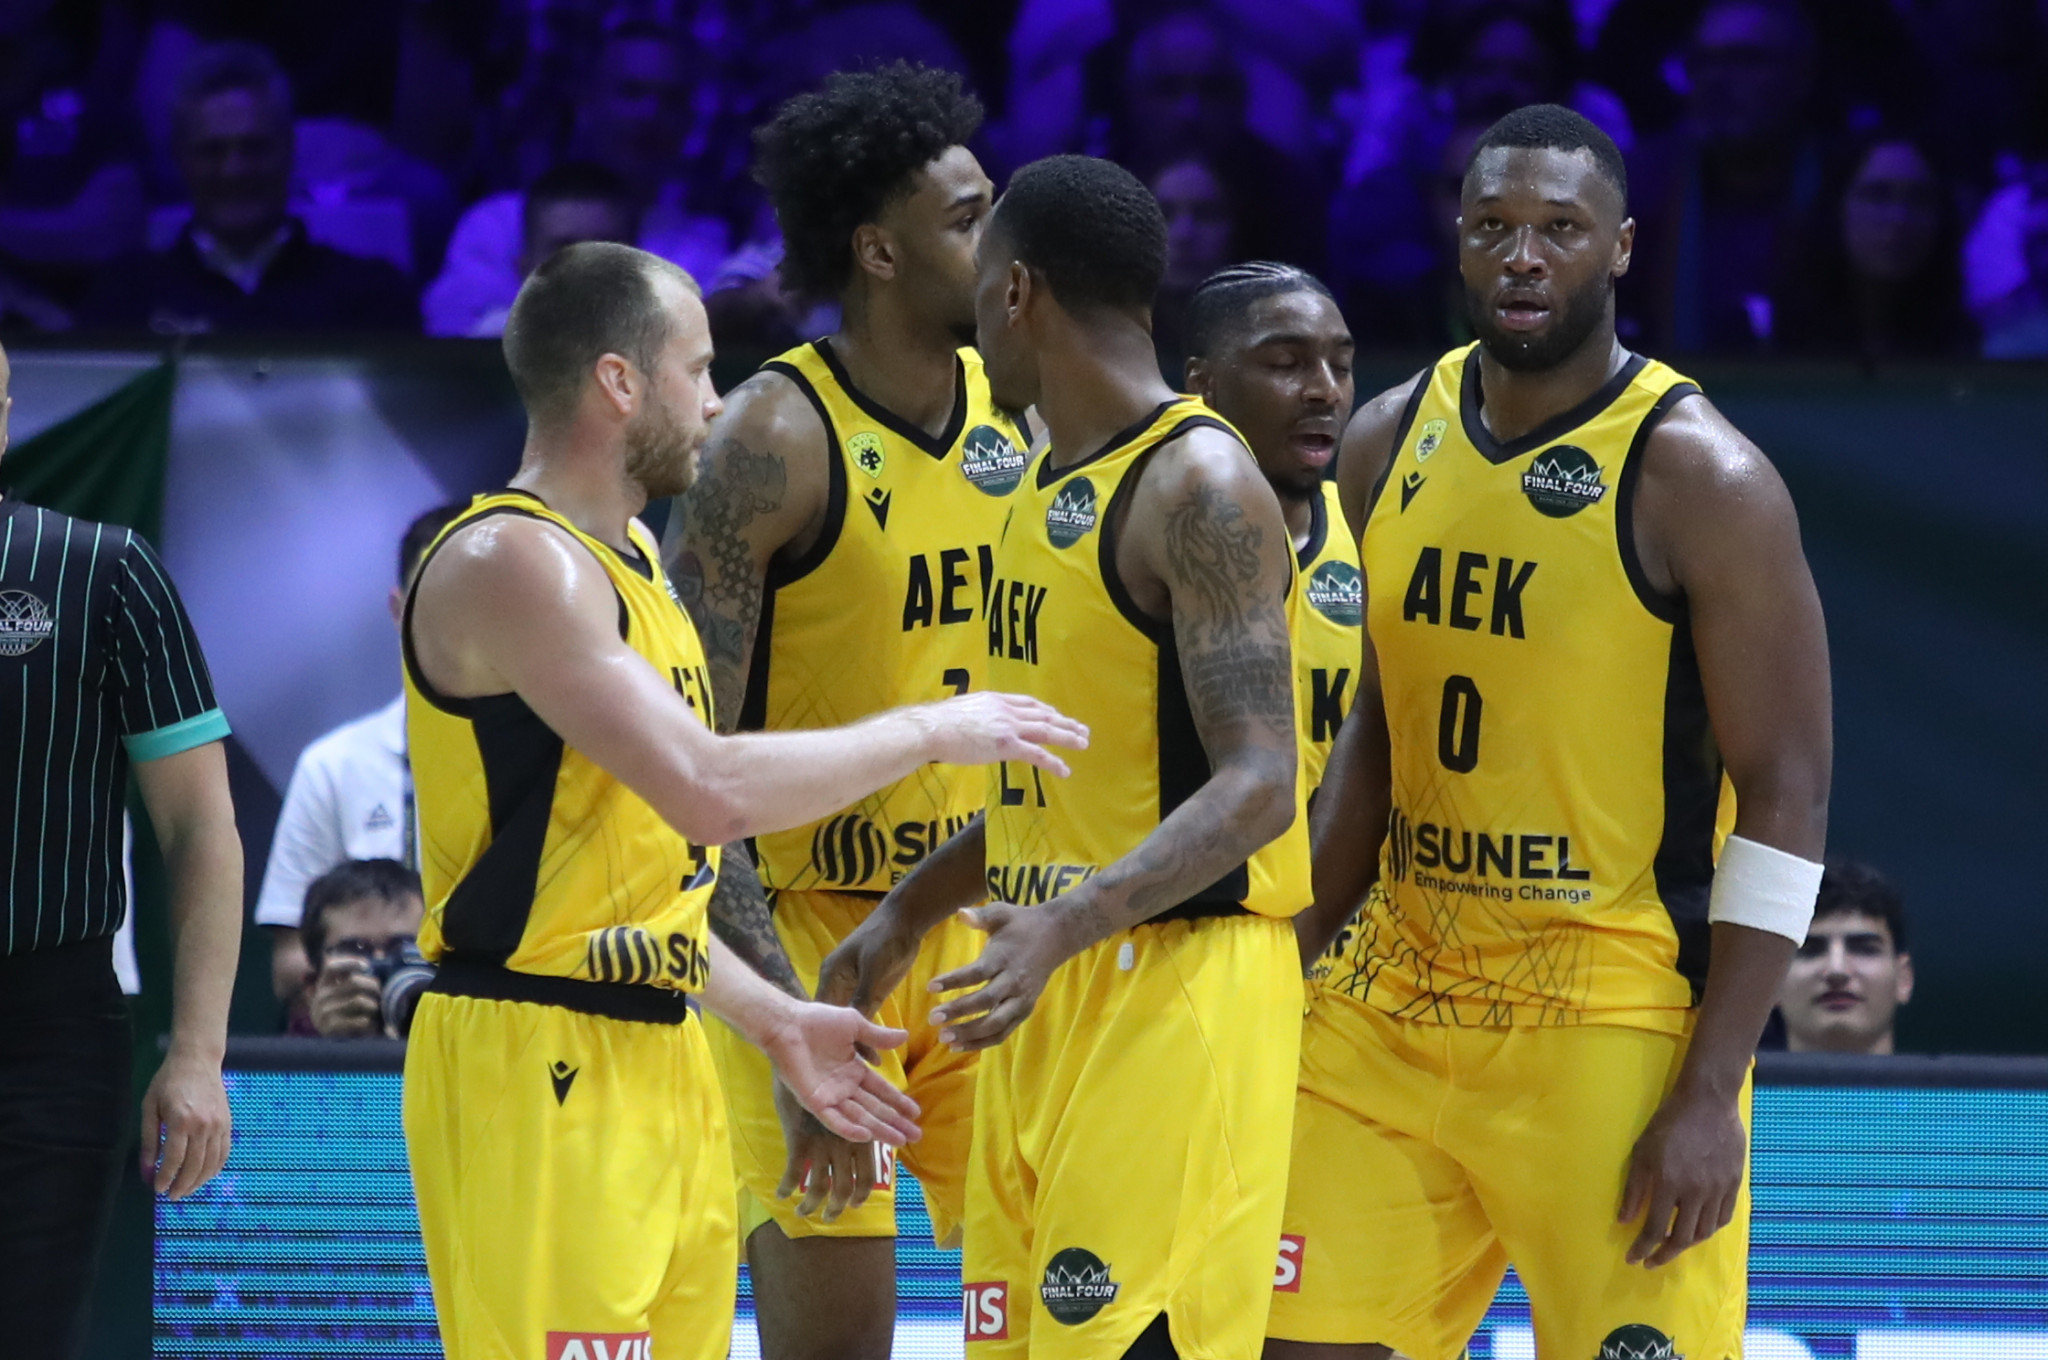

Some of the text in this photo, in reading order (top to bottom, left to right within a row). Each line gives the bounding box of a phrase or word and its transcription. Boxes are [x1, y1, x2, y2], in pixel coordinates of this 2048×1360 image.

[963, 460, 997, 475] FINAL
[996, 455, 1025, 470] FOUR
[1524, 475, 1562, 491] FINAL
[1563, 481, 1603, 498] FOUR
[1048, 509, 1069, 522] FINAL
[1069, 512, 1095, 526] FOUR
[1309, 592, 1348, 603] FINAL
[1403, 546, 1538, 640] AEK
[15, 621, 53, 632] FOUR
[989, 578, 1047, 666] AEK
[1438, 674, 1483, 774] 0
[1414, 822, 1590, 880] SUNEL
[1414, 871, 1591, 904] Empowering Change
[1042, 1285, 1114, 1298] FINAL FOUR
